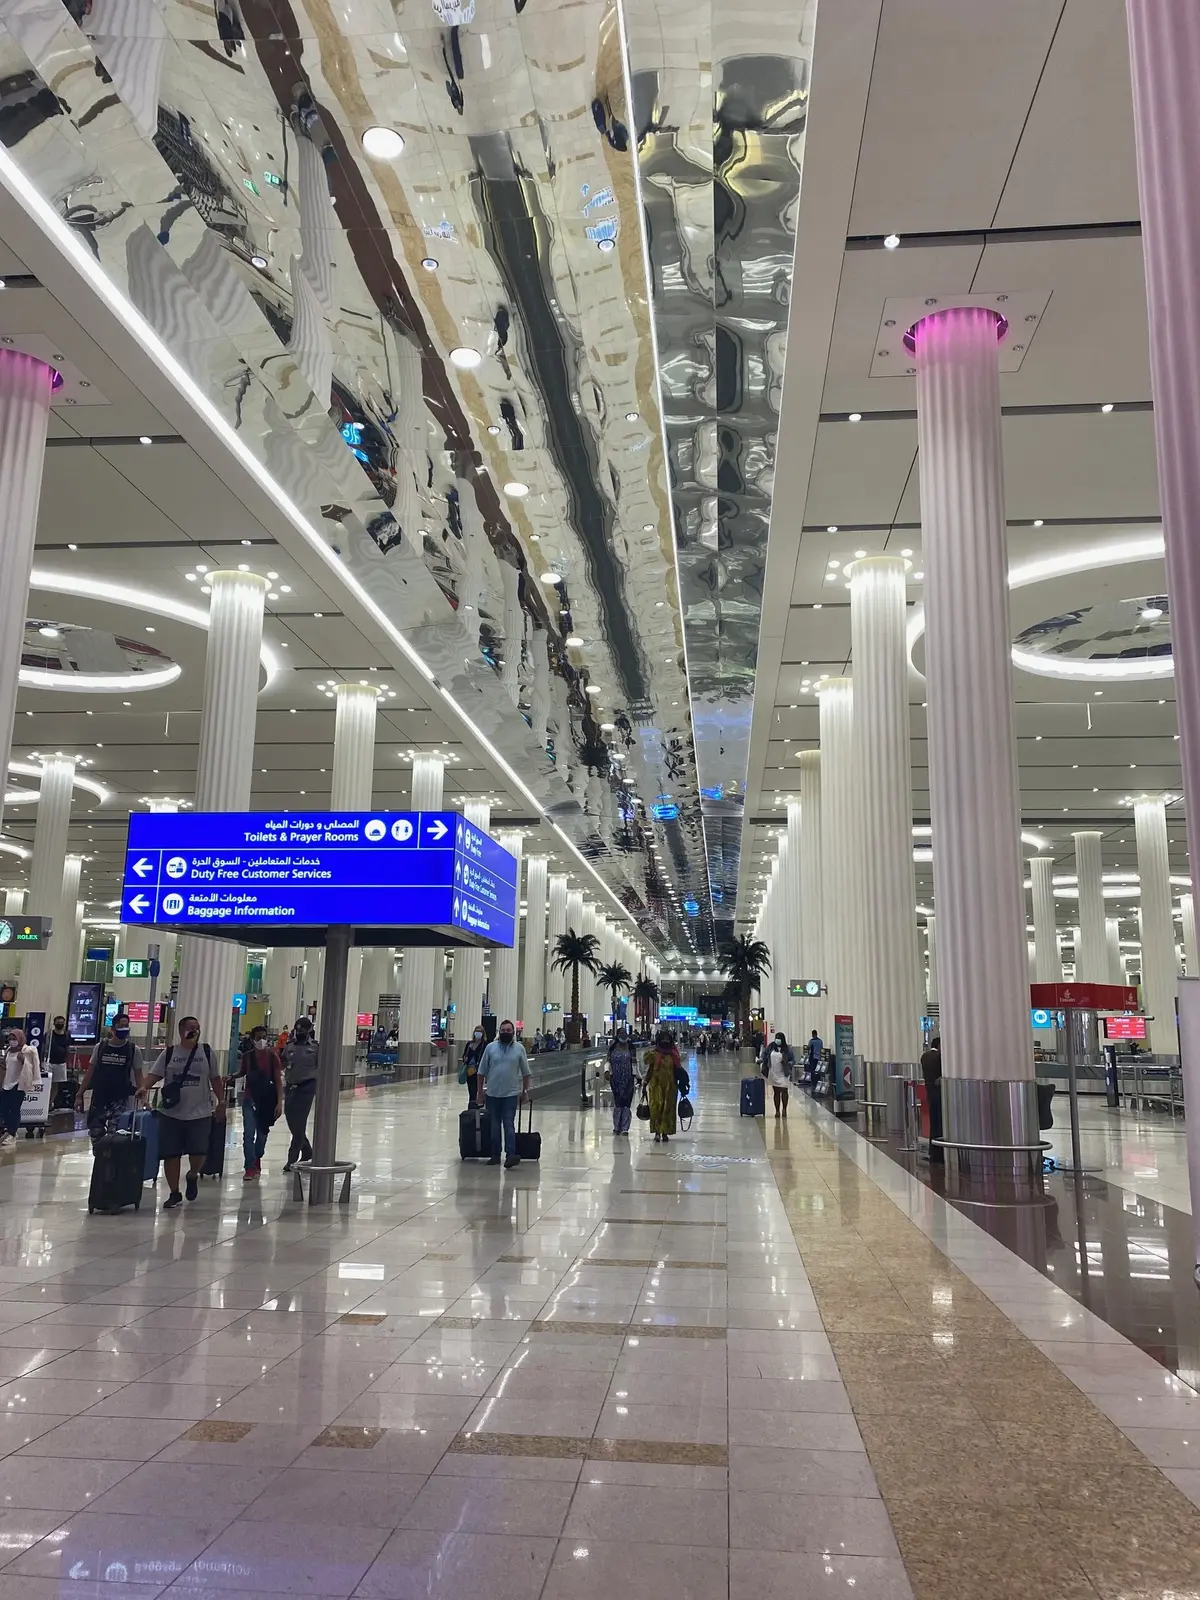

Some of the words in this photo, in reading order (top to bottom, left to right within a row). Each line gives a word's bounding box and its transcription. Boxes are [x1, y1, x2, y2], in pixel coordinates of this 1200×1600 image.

[265, 819, 288, 831] المياه
[289, 820, 314, 830] دورات
[244, 832, 277, 842] Toilets
[279, 832, 288, 842] &
[290, 832, 322, 844] Prayer
[324, 832, 359, 842] Rooms
[192, 857, 211, 867] الحرة
[212, 857, 240, 868] السوق
[248, 857, 291, 867] المتعاملين
[293, 857, 320, 866] خدمات
[191, 869, 215, 880] Duty
[217, 869, 239, 879] Free
[241, 869, 290, 879] Customer
[292, 869, 332, 879] Services
[189, 892, 219, 903] الأمتعة
[220, 893, 257, 904] معلومات
[188, 905, 232, 918] Baggage
[234, 905, 295, 916] Information
